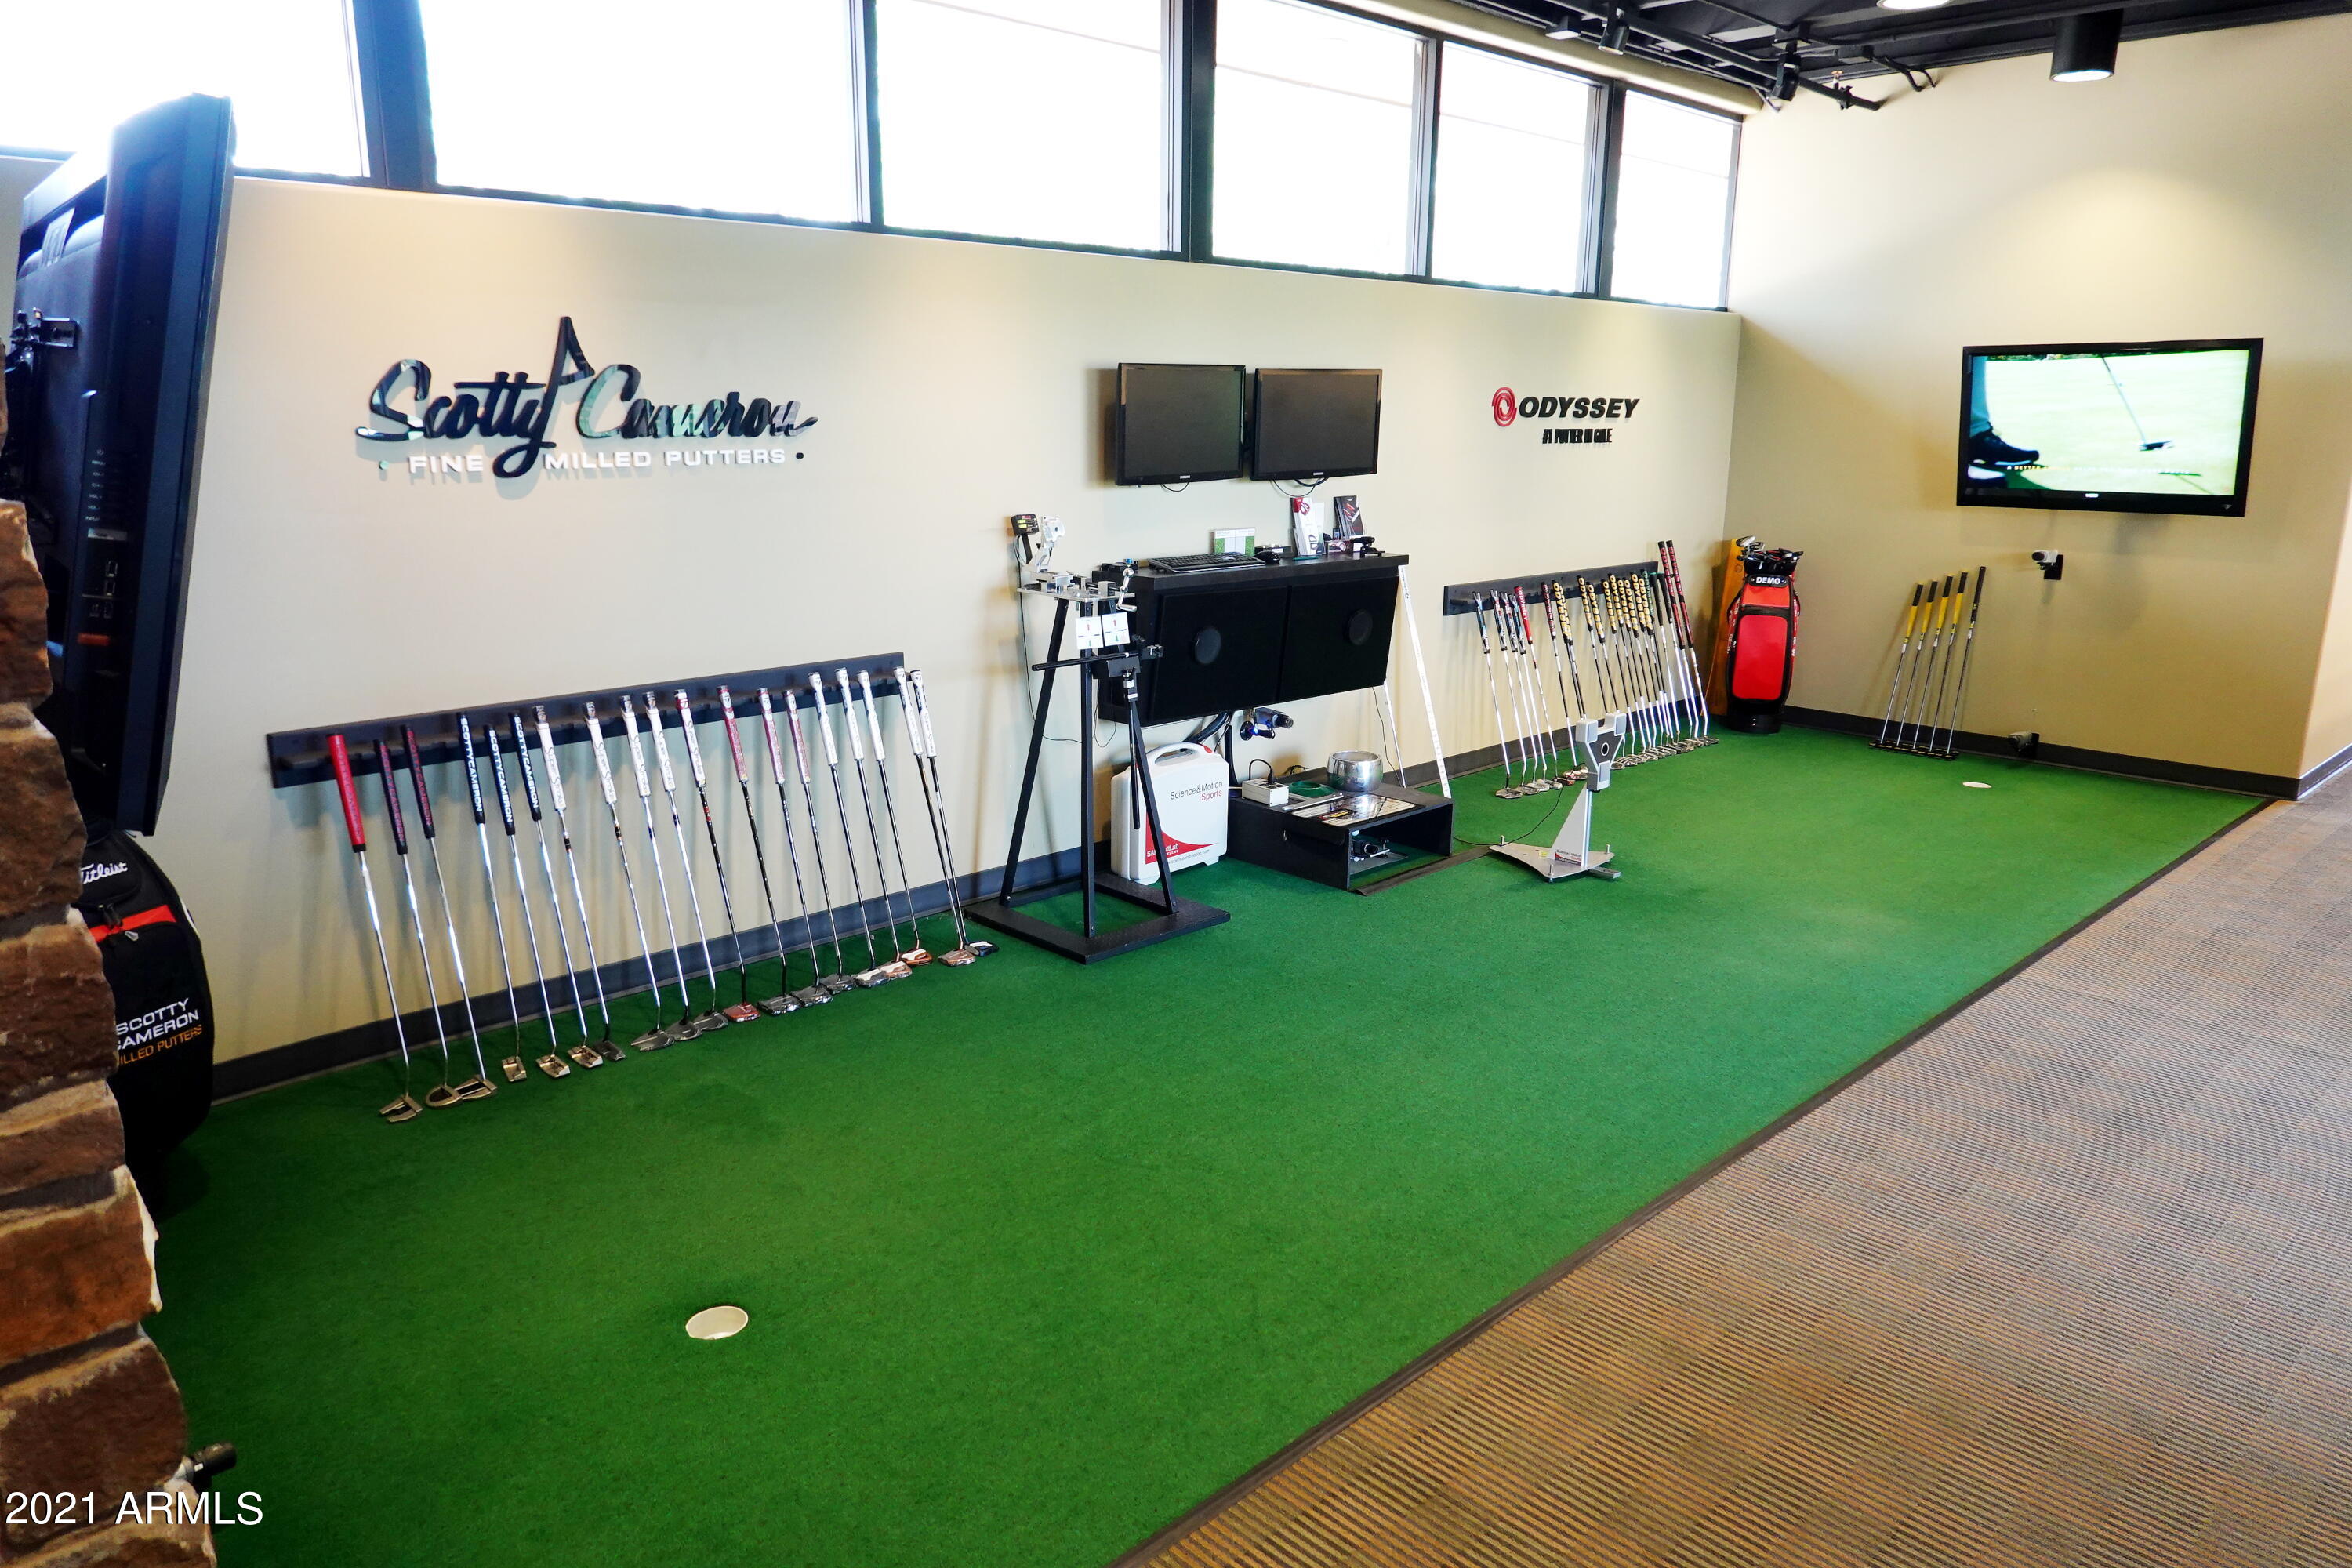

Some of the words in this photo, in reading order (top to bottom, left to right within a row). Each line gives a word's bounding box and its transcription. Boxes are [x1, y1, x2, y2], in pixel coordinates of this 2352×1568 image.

[355, 316, 594, 478] Scotty
[576, 364, 818, 439] Cameron
[1518, 396, 1640, 419] ODYSSEY
[408, 455, 484, 474] FINE
[544, 451, 652, 470] MILLED
[664, 448, 786, 467] PUTTERS
[1755, 576, 1781, 585] DEMO
[1201, 789, 1222, 801] Sports
[115, 998, 189, 1035] SCOTTY
[120, 1045, 154, 1065] ILLED
[158, 1024, 202, 1052] PUTTERS
